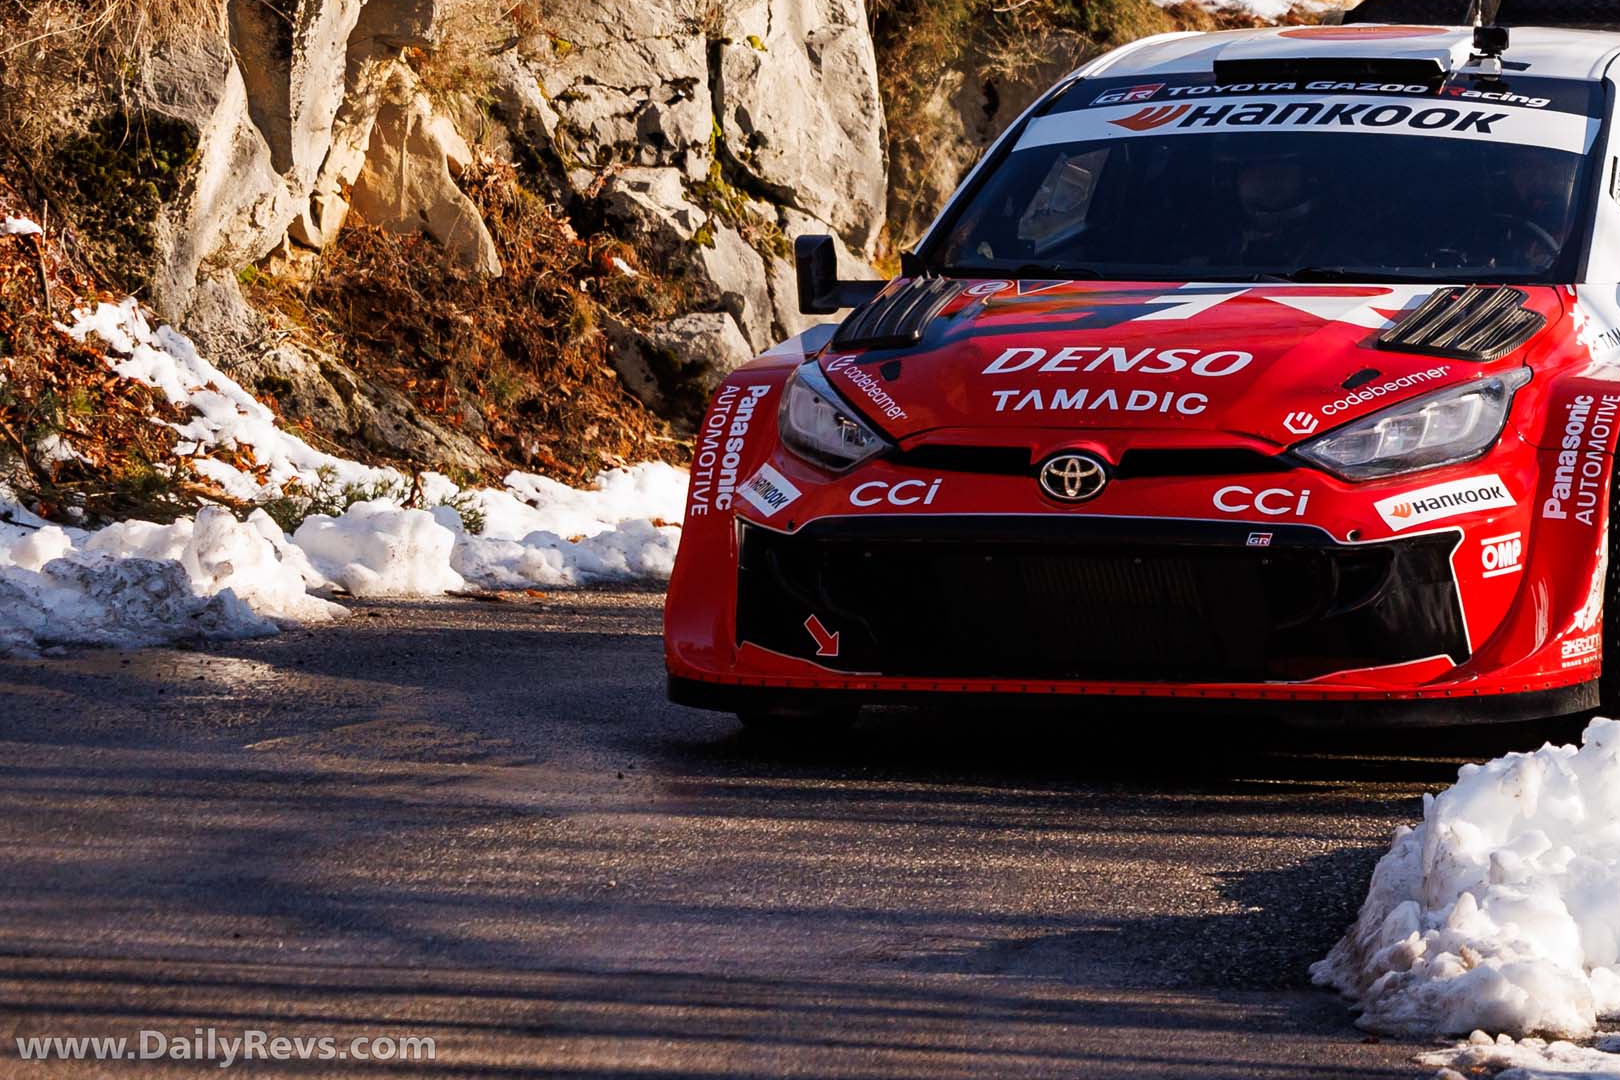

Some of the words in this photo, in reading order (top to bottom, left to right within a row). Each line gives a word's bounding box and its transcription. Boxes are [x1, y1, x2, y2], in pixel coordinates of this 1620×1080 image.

[1168, 81, 1297, 97] TOYOTA
[1305, 80, 1428, 94] GAZOO
[1447, 86, 1551, 107] Racing
[981, 347, 1253, 377] DENSO
[843, 364, 906, 420] codebeamer
[991, 389, 1209, 415] TAMADIC
[1322, 367, 1448, 416] codebeamer
[691, 385, 741, 517] AUTOMOTIVE
[715, 385, 771, 511] Panasonic
[1543, 394, 1594, 520] Panasonic
[1482, 540, 1521, 571] OMP
